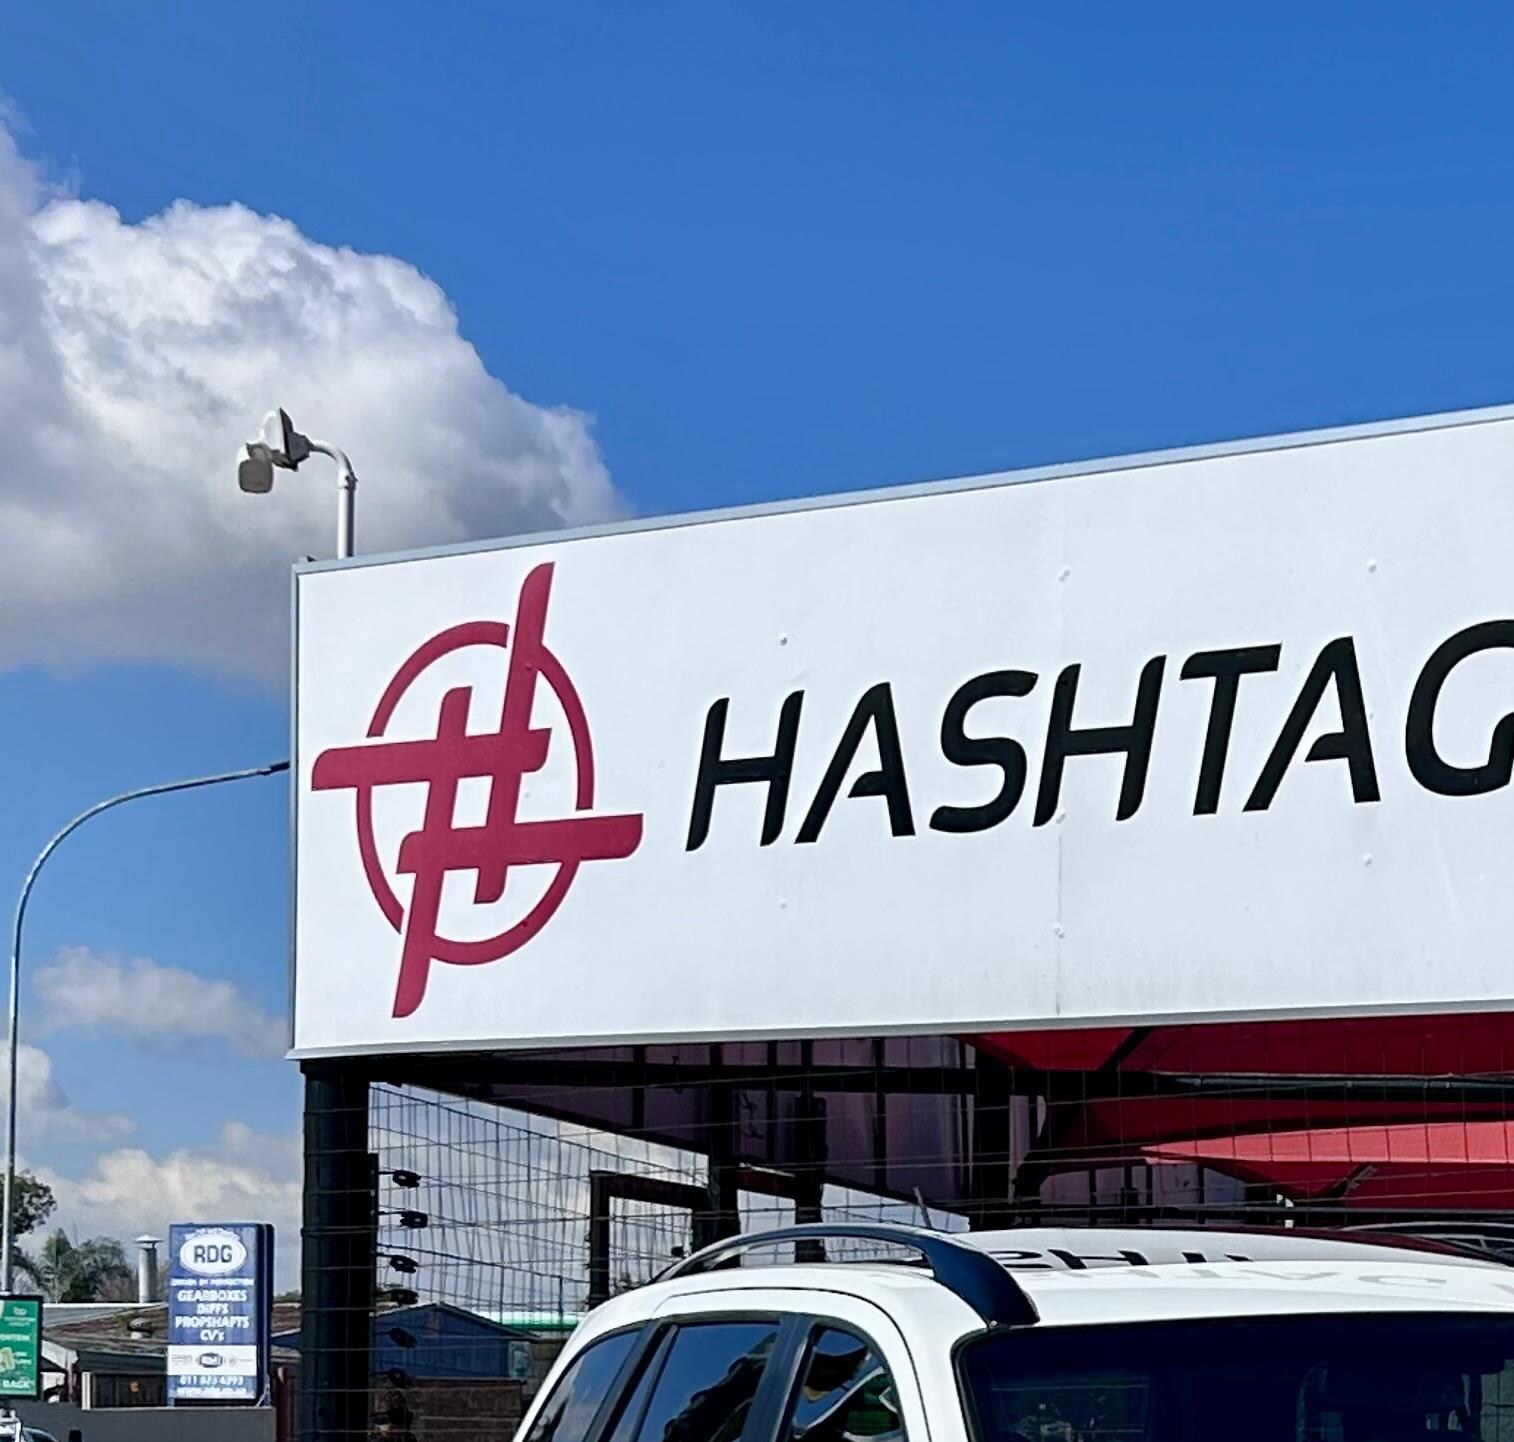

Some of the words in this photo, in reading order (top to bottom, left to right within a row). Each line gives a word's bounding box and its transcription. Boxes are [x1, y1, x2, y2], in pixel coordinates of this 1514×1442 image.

[193, 1244, 233, 1264] RDG
[177, 1289, 248, 1302] GEARBOXES
[197, 1302, 229, 1315] DIFFS
[175, 1315, 249, 1329] PROPSHAFTS
